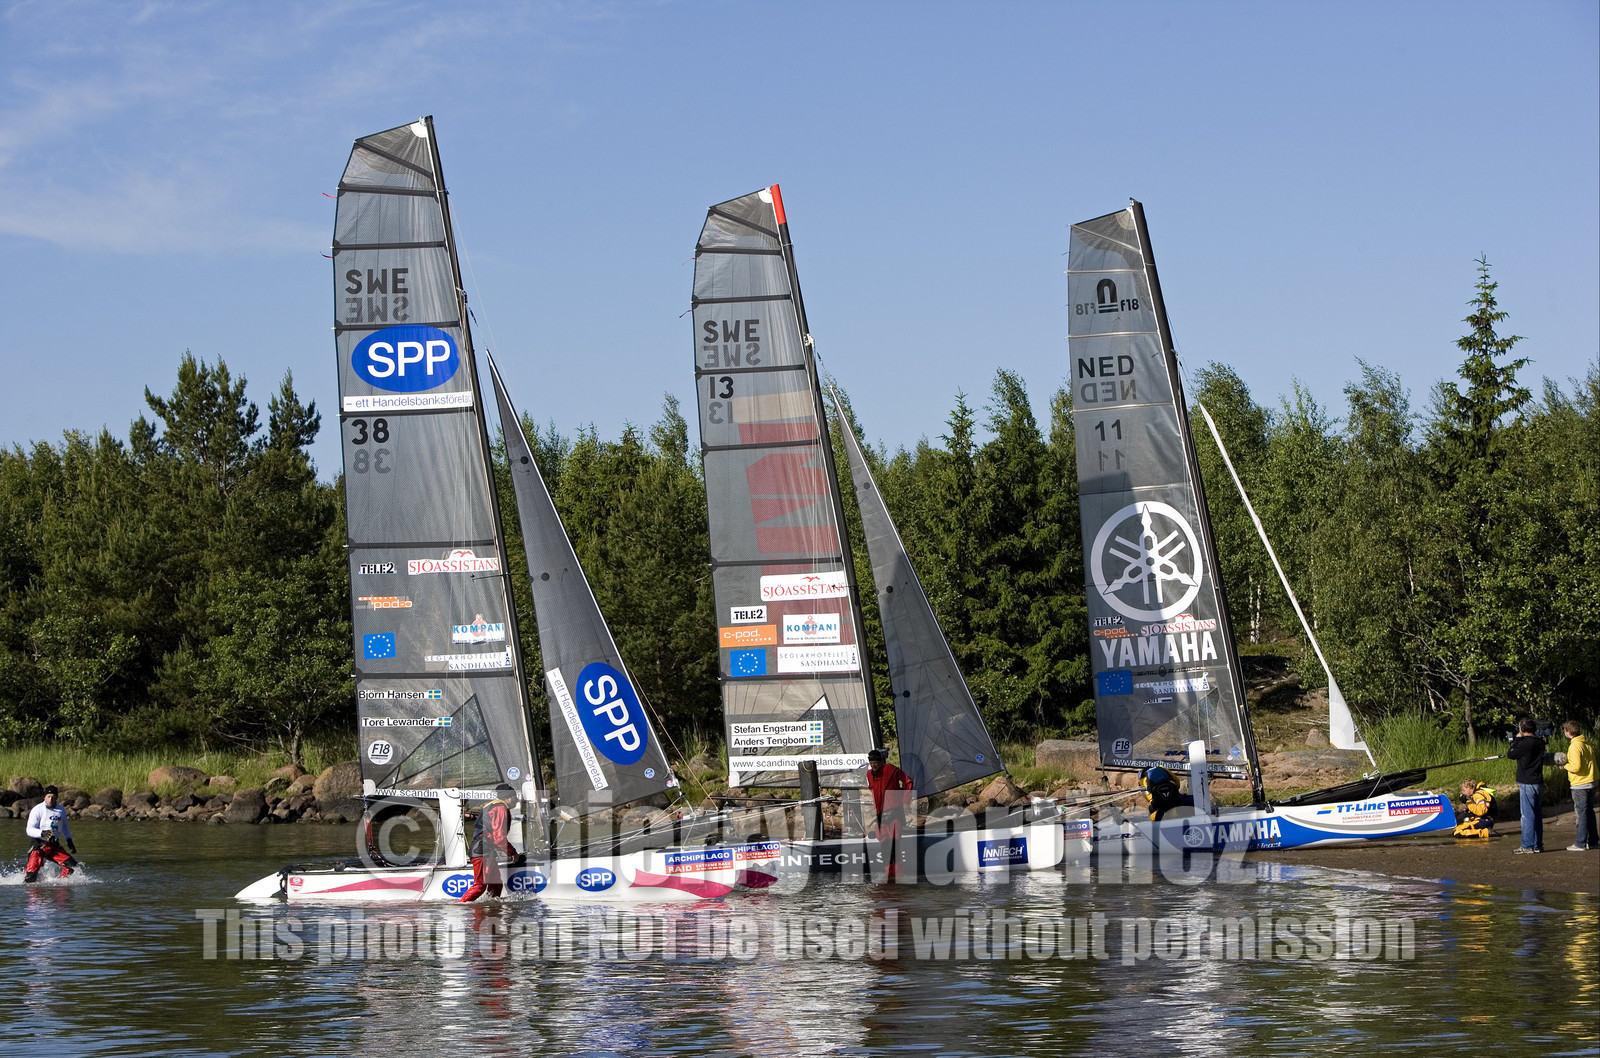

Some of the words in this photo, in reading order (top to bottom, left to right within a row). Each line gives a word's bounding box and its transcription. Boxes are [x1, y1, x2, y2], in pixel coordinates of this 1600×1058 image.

[345, 268, 409, 294] SWE
[703, 319, 760, 343] SWE
[367, 339, 451, 378] SPP
[1078, 355, 1134, 378] NED
[710, 376, 734, 399] 13
[355, 397, 370, 408] ett
[351, 418, 390, 445] 38
[1095, 419, 1122, 441] 11
[361, 563, 394, 574] TELE2
[409, 557, 499, 575] SJÖASSISTANS
[763, 582, 845, 598] SJÖASSISTANS
[734, 609, 763, 619] TELE2
[1094, 616, 1123, 626] TELE2
[453, 623, 505, 633] KOMPANI
[787, 624, 836, 632] KOMPANI
[1141, 619, 1217, 636] SJÖASSISTANS
[1099, 631, 1218, 668] YAMAHA
[449, 661, 502, 670] SANDHAMN
[358, 690, 385, 700] Björn
[387, 691, 425, 699] Hansen
[584, 675, 641, 751] SPP
[362, 718, 385, 726] Tore
[387, 718, 435, 726] Lewander
[734, 724, 761, 734] Stefan
[763, 723, 807, 735] Engstrand
[560, 690, 604, 790] Handelsbanksföretag
[734, 737, 764, 746] Anders
[767, 736, 807, 747] Tengbom
[1115, 740, 1130, 750] F18
[372, 744, 390, 754] F18
[1337, 802, 1386, 814] TT-Line
[1390, 799, 1439, 807] ARCHIPELAGO
[1205, 819, 1282, 844] YAMAHA
[668, 852, 730, 863] ARCHIPELAGO
[668, 865, 692, 873] RAID
[512, 875, 543, 889] SPP
[580, 872, 612, 887] SPP
